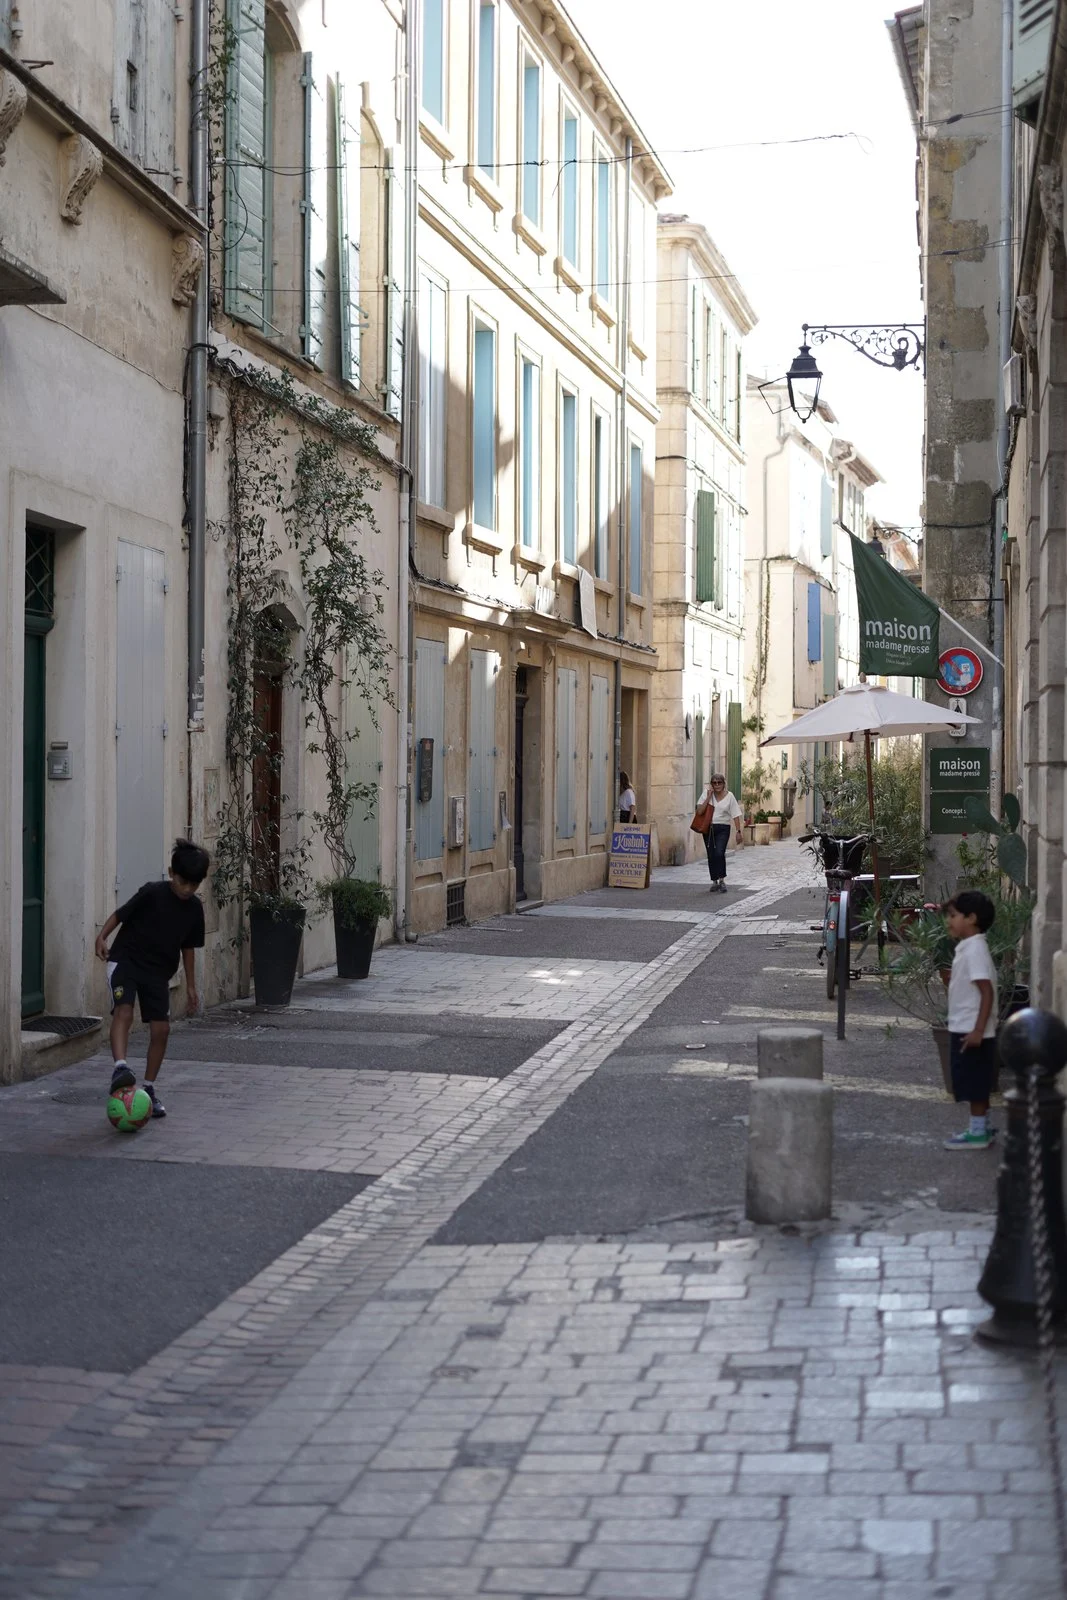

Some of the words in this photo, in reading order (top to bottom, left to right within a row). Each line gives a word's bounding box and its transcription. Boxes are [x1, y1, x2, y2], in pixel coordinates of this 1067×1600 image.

[865, 617, 931, 640] maison
[865, 639, 902, 652] madame
[903, 644, 930, 655] presse
[939, 757, 981, 770] maison
[963, 770, 980, 778] presse
[941, 807, 963, 816] Concept
[610, 861, 648, 869] RETOUCHES
